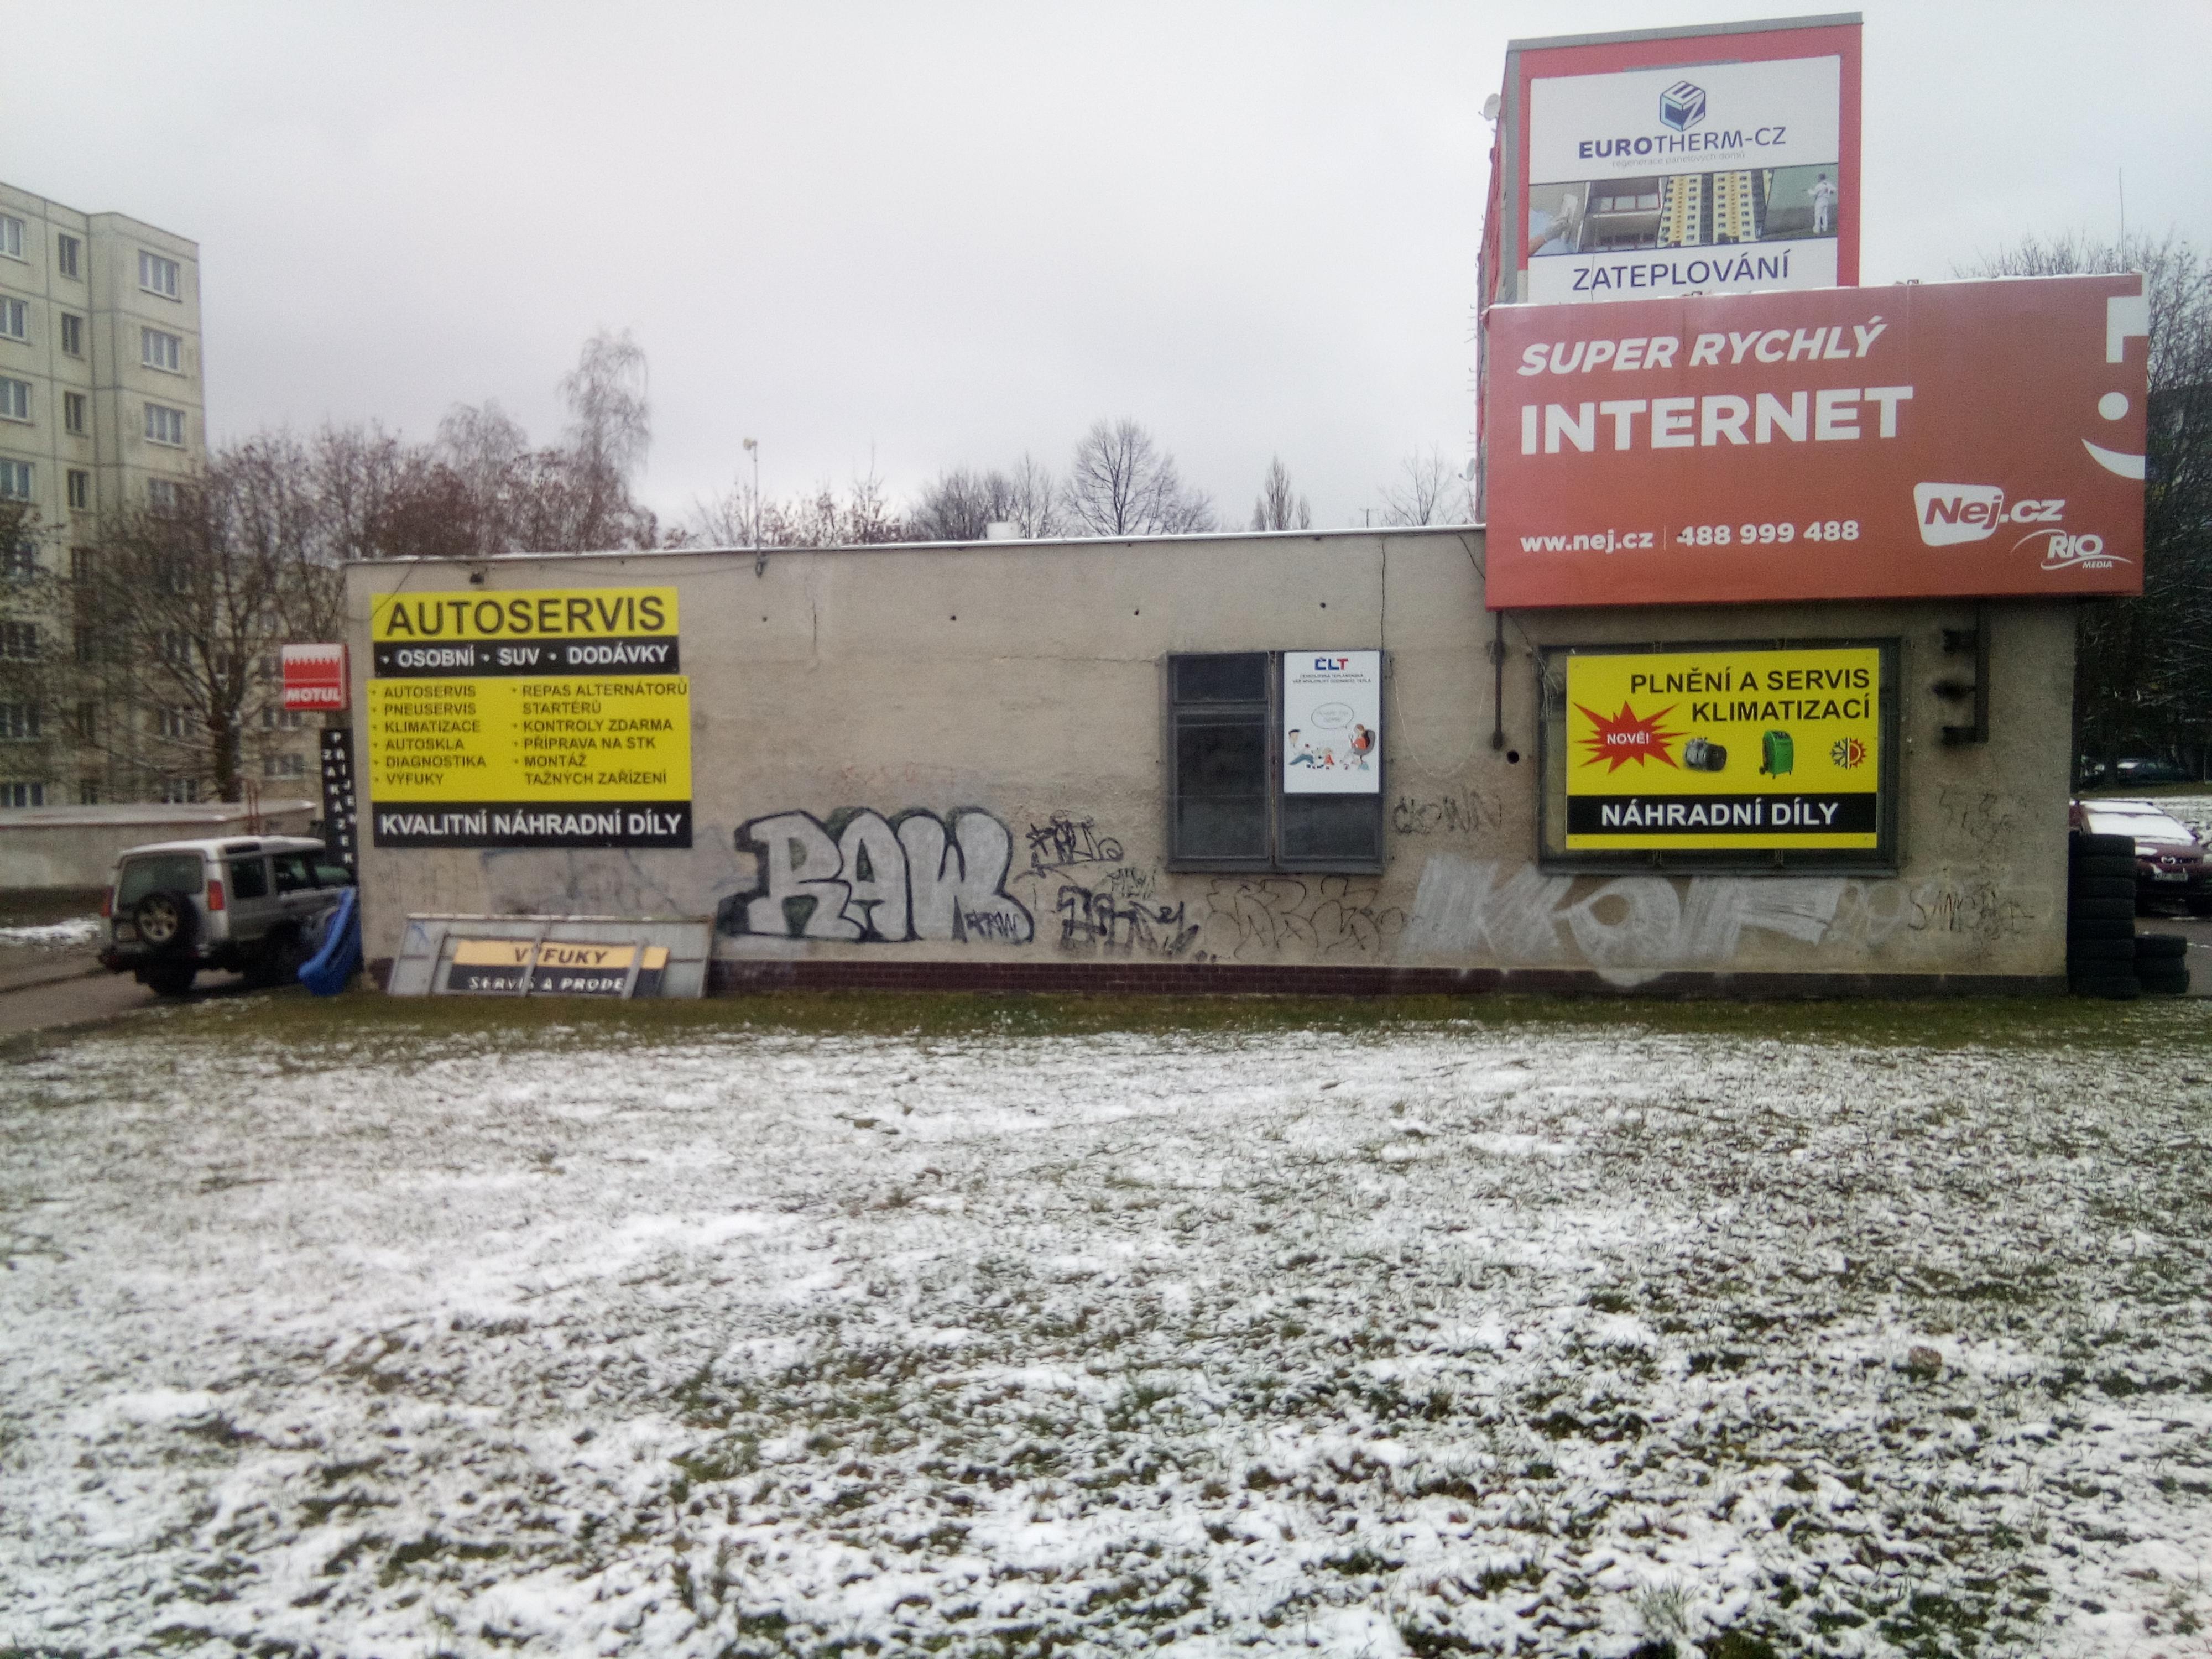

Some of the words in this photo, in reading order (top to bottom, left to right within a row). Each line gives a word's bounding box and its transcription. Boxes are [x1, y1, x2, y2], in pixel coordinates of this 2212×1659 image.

[1578, 126, 1787, 159] EUROTHERM-CZ
[1612, 156, 1663, 169] regenerace
[1572, 249, 1791, 291] ZATEPLOVÁNÍ
[1516, 336, 1679, 377] SUPER
[1689, 315, 1888, 367] RYCHLÝ
[1520, 385, 1914, 456] INTERNET
[1924, 495, 2065, 530] Nej.cz
[1676, 525, 1731, 547] 488
[1739, 524, 1795, 545] 999
[1803, 520, 1859, 542] 488
[2047, 534, 2103, 559] RIO
[2082, 560, 2113, 569] MEDIA
[385, 596, 666, 637] AUTOSERVIS
[398, 645, 475, 668] OSOBNÍ
[498, 648, 540, 666] SUV
[567, 641, 669, 664] DODÁVKY
[523, 684, 571, 697] REPAS
[576, 678, 687, 697] ALTERNÁTORŮ
[1630, 666, 1731, 694] PLNĚNÍ
[1739, 671, 1758, 691] A
[1767, 669, 1870, 691] SERVIS
[286, 687, 340, 702] MOTUL
[384, 685, 476, 698] AUTOSERVIS
[384, 703, 476, 716] PNEUSERVIS
[523, 699, 602, 714] STARTÉRŮ
[1692, 693, 1870, 722] KLIMATIZACÍ
[385, 720, 480, 733] KLIMATIZACE
[524, 719, 604, 732] KONTROLY
[608, 718, 673, 731] ZDARMA
[385, 738, 465, 751] AUTOSKLA
[524, 734, 598, 749] PŘÍPRAVA
[602, 737, 623, 749] NA
[627, 737, 656, 749] STK
[387, 755, 487, 767] DIAGNOSTIKA
[524, 751, 587, 768] MONTÁŽ
[525, 770, 593, 785] TAŽNÝCH
[598, 768, 667, 785] ZAŘÍZENÍ
[1601, 797, 1762, 827] NÁHRADNÍ
[1771, 796, 1839, 826] DÍLY
[382, 808, 487, 836] KVALITNÍ
[493, 808, 622, 836] NÁHRADNÍ
[628, 808, 682, 836] DÍLY
[514, 947, 608, 964] VFUKY
[541, 977, 553, 991] A
[559, 977, 627, 992] PRODE
